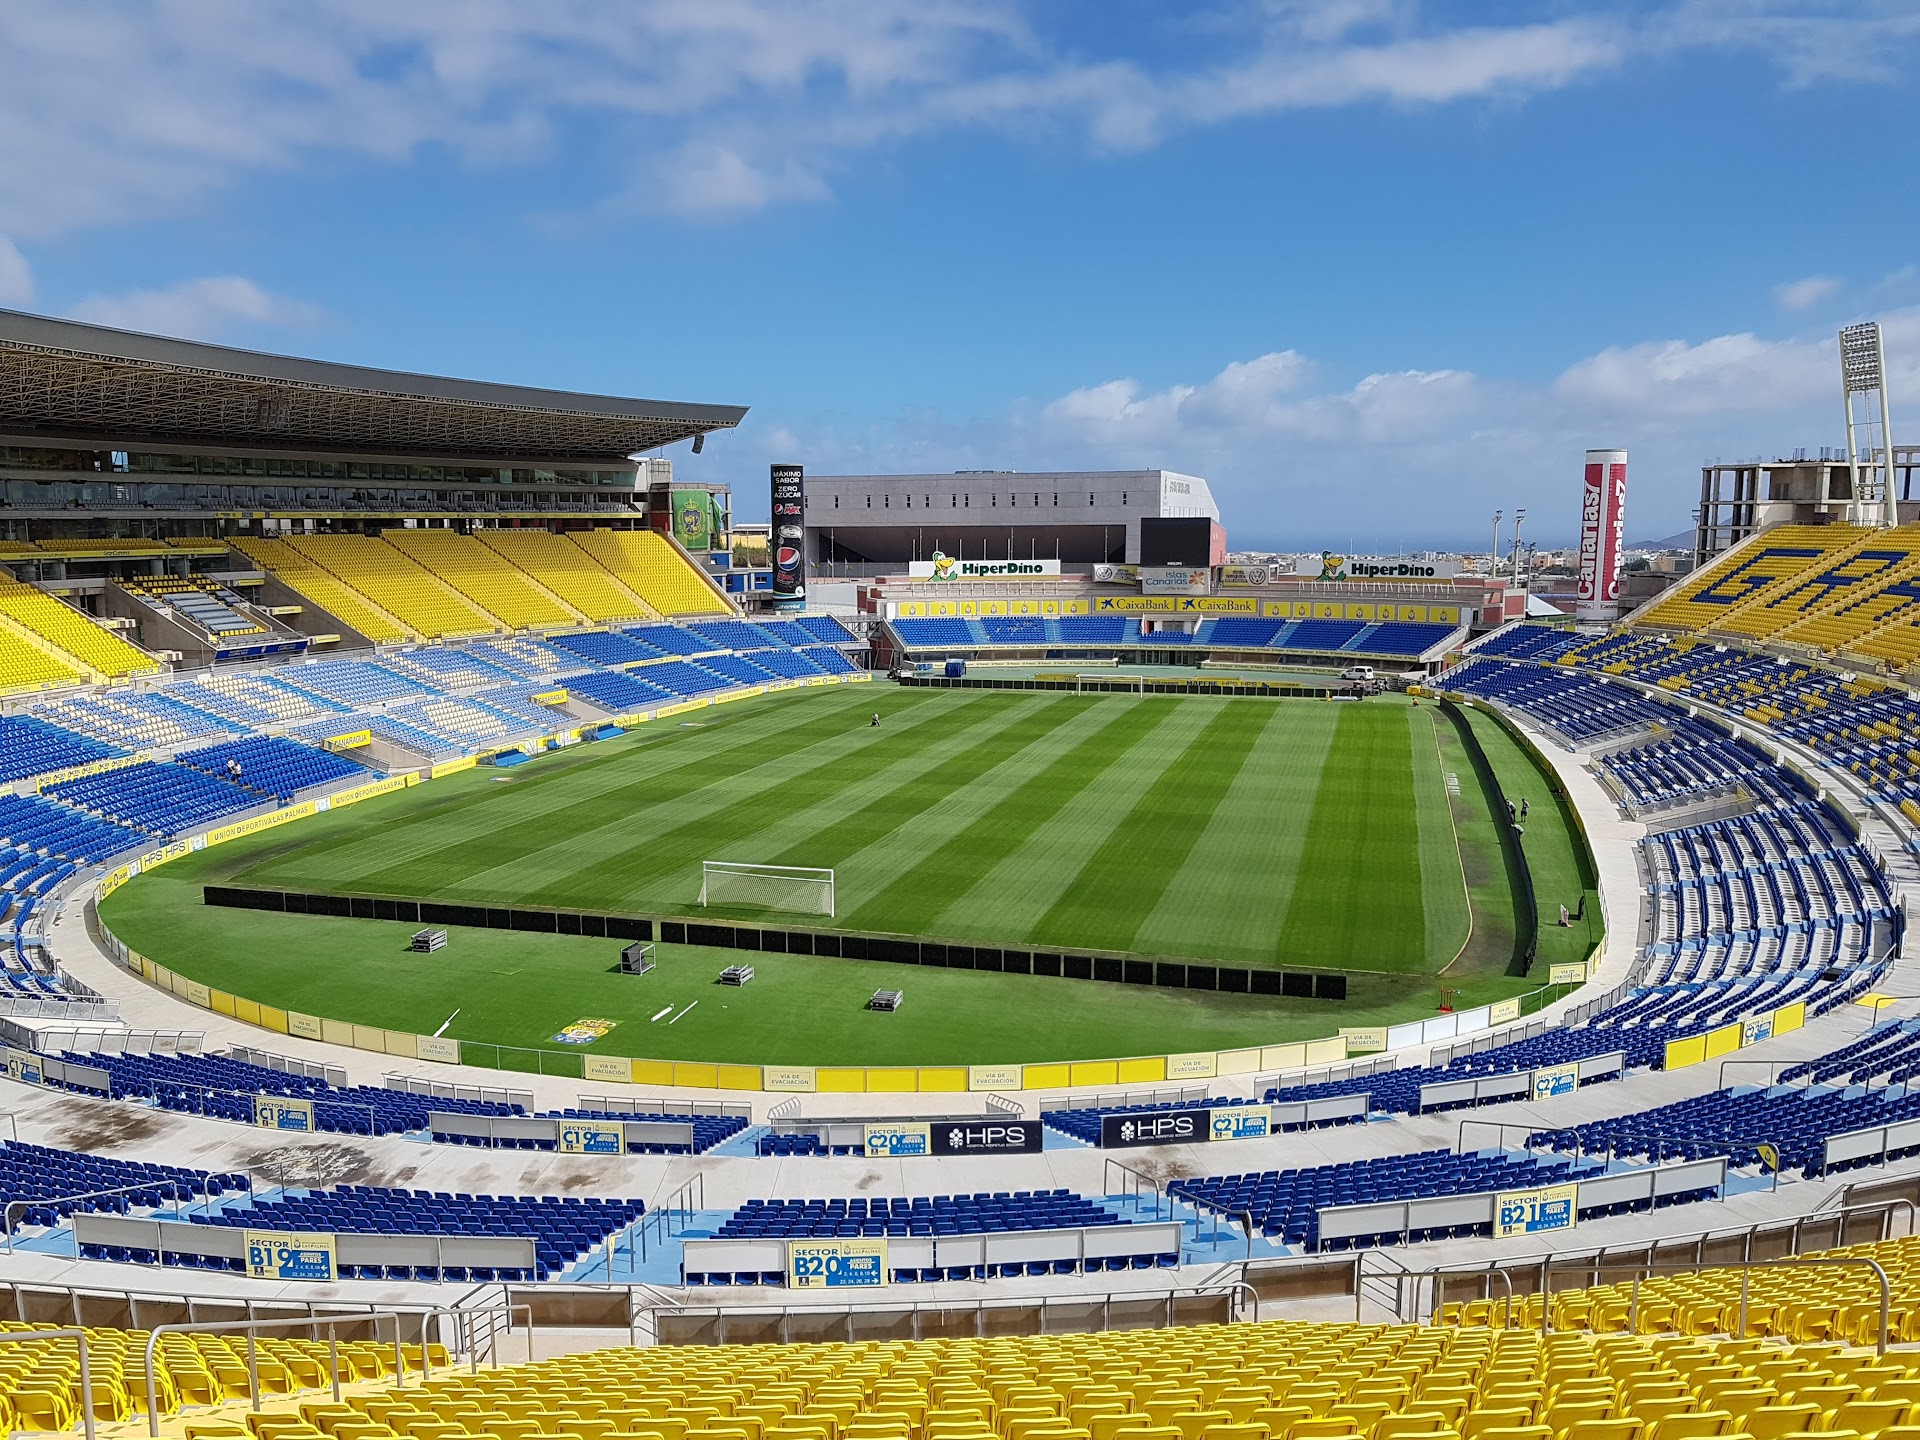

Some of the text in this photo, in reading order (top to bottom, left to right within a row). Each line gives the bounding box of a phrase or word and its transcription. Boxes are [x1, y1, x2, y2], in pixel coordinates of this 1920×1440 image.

[1577, 480, 1601, 600] Canarias7
[962, 561, 1043, 577] HiperDino
[1351, 563, 1435, 578] HiperDino
[1146, 578, 1188, 586] Canarias
[1116, 598, 1170, 610] CaixaBank
[1198, 599, 1252, 611] CaixaBank
[130, 668, 155, 677] SPAR
[236, 816, 272, 834] DEPORTIVA
[272, 814, 284, 825] LAS
[284, 806, 308, 820] PALMAS
[144, 841, 186, 867] HPS HPS
[1537, 1072, 1557, 1080] SECTOR
[1536, 1077, 1558, 1092] C22
[259, 1107, 285, 1121] C18
[1137, 1117, 1194, 1137] HPS
[1213, 1118, 1241, 1132] C21
[563, 1131, 594, 1144] C19
[868, 1134, 900, 1148] C20
[966, 1127, 1025, 1144] HPS
[1502, 1197, 1538, 1206] SECTOR
[1501, 1204, 1539, 1226] B21
[1546, 1206, 1565, 1215] PARES
[250, 1239, 289, 1248] SECTOR
[249, 1247, 292, 1267] B19
[794, 1256, 840, 1276] B20
